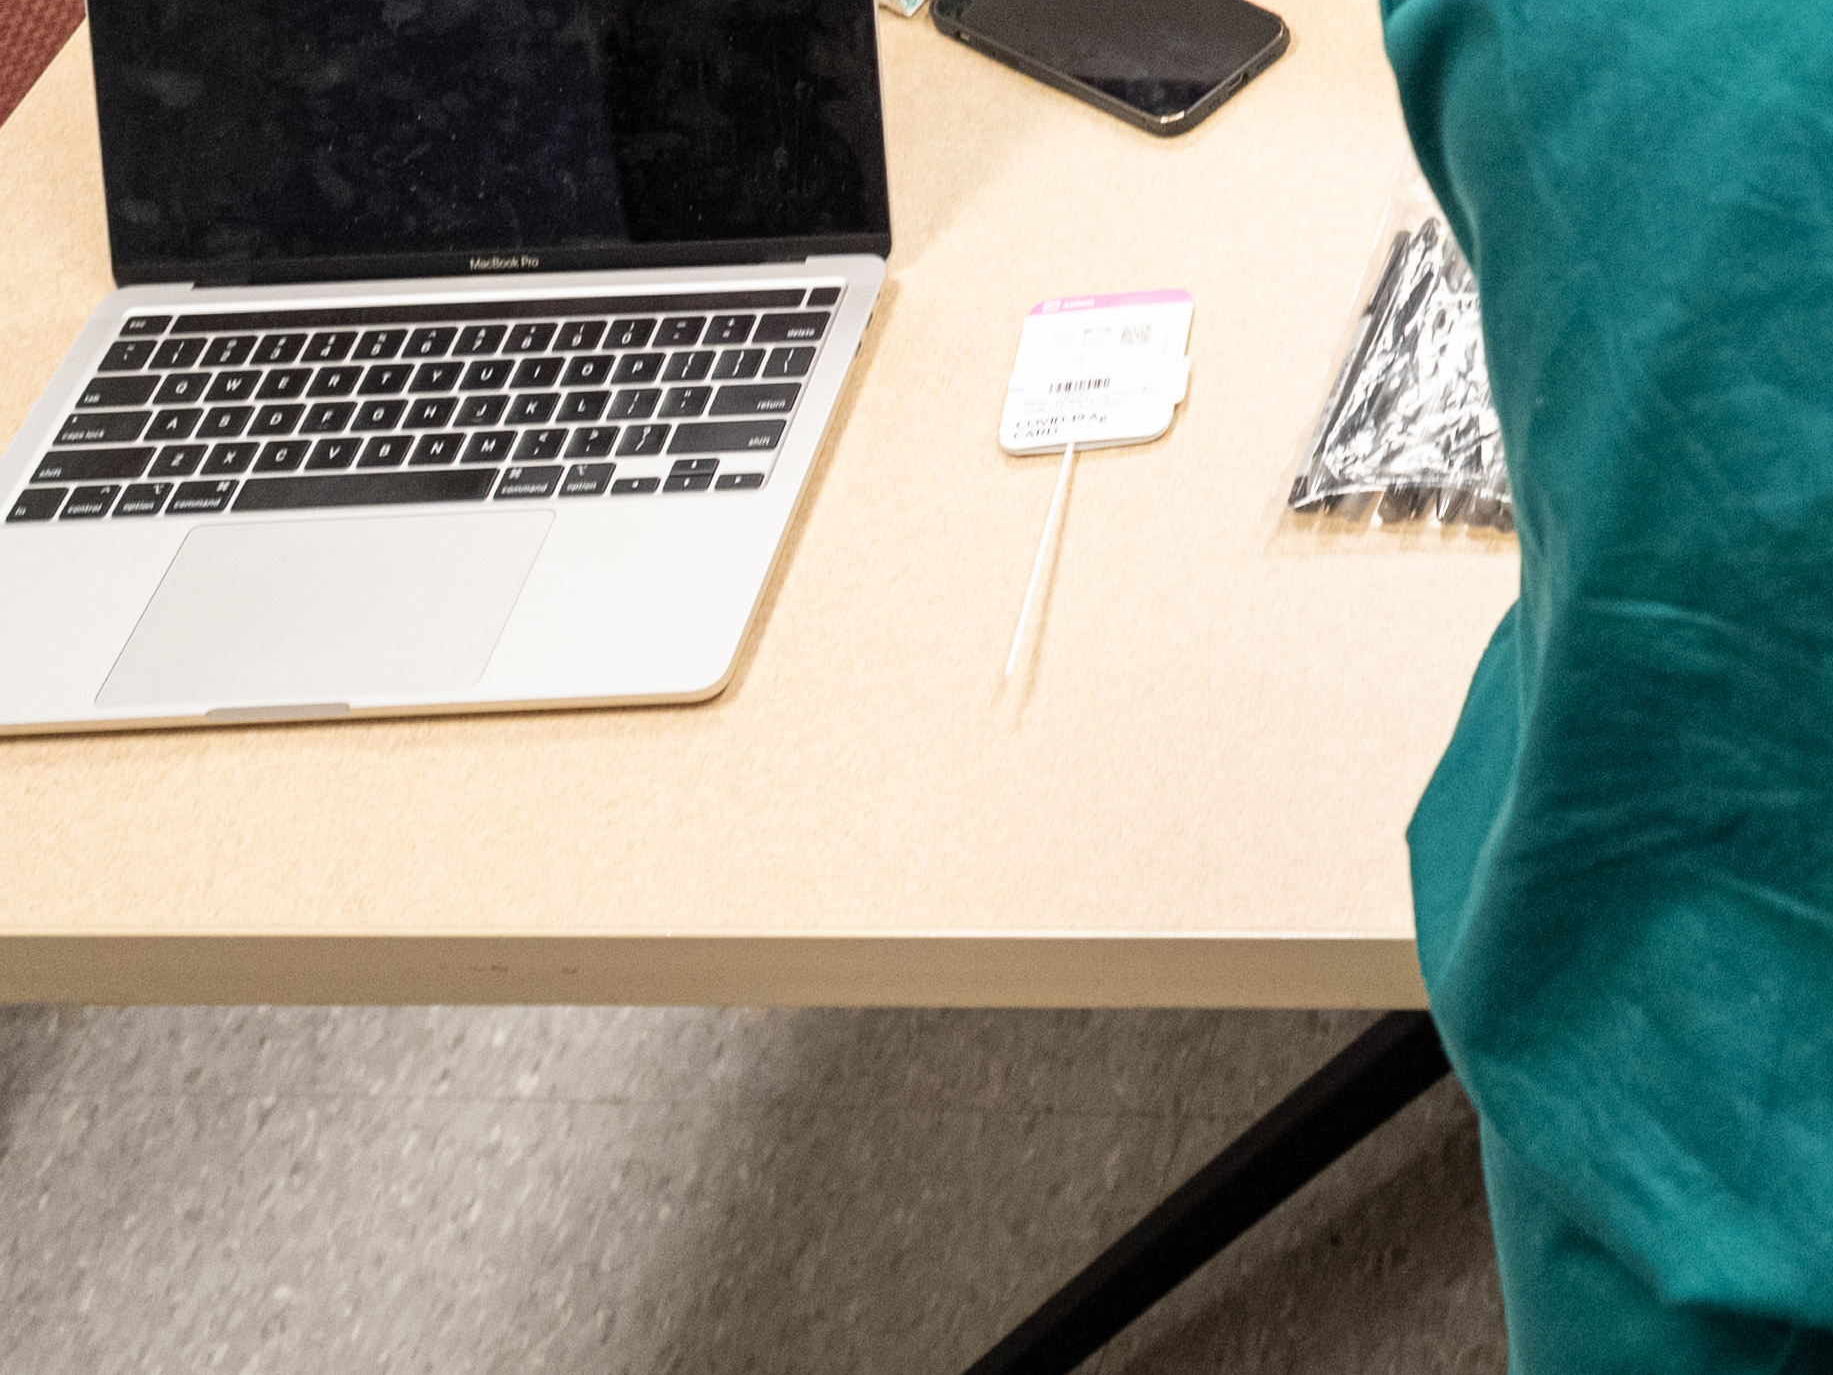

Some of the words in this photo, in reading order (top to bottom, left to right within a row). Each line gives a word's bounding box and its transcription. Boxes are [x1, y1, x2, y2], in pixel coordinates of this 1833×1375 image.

[470, 255, 519, 270] MacBook
[521, 255, 539, 268] Pro
[582, 363, 594, 376] O
[632, 361, 644, 373] P
[381, 372, 392, 385] T
[432, 370, 442, 382] Y
[481, 368, 493, 380] U
[226, 379, 242, 391] W
[328, 374, 340, 387] R
[175, 381, 188, 393] Q
[525, 401, 538, 414] K
[577, 399, 585, 412] L
[756, 399, 786, 409] return
[322, 410, 334, 423] F
[424, 406, 436, 418] H
[476, 404, 487, 417] J
[166, 417, 178, 429] A
[270, 413, 282, 425] D
[39, 469, 62, 477] shift
[501, 483, 548, 495] command
[567, 481, 596, 491] option
[68, 503, 102, 513] control
[123, 502, 154, 511] option
[174, 498, 221, 509] command
